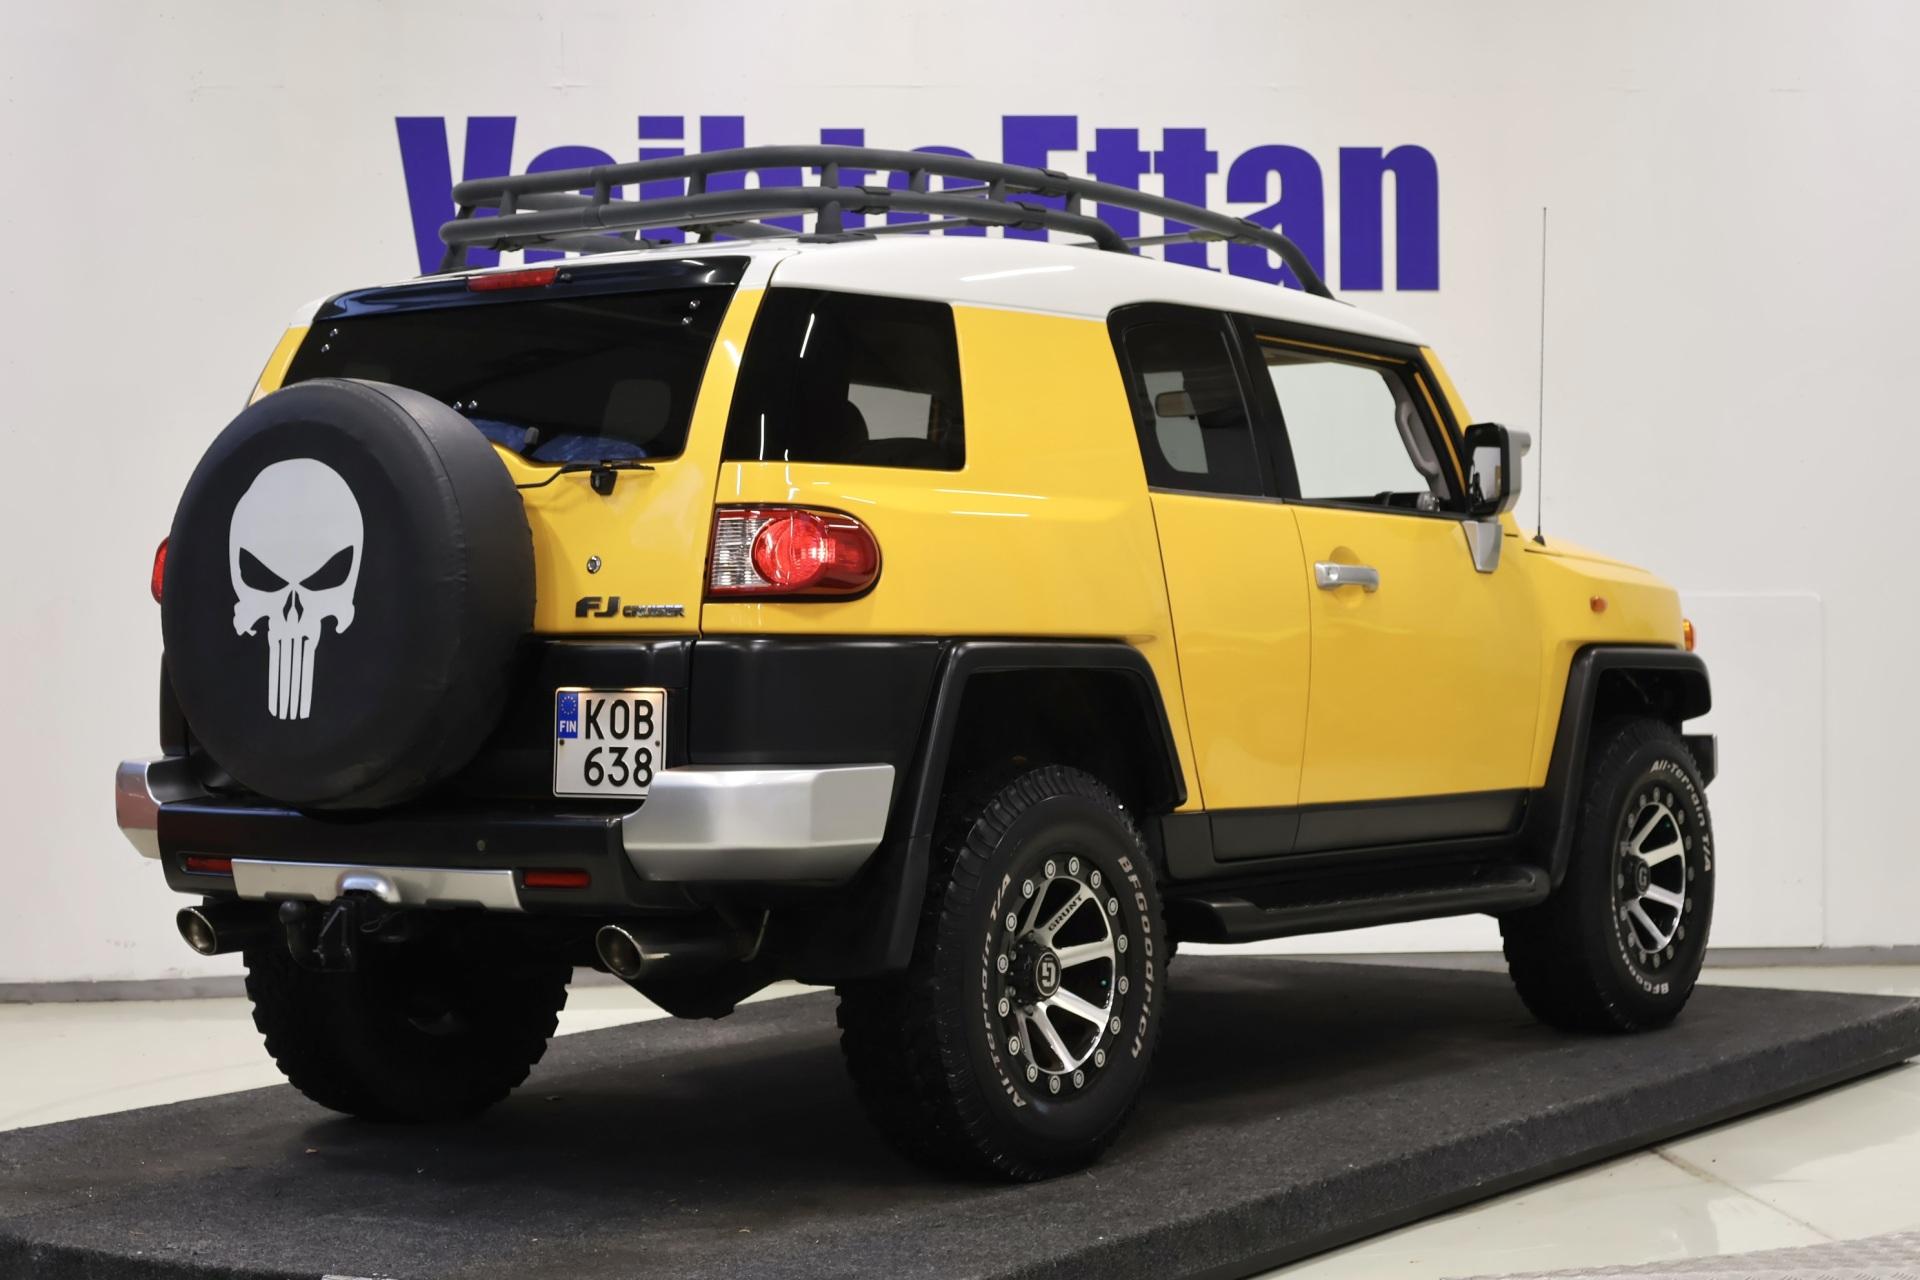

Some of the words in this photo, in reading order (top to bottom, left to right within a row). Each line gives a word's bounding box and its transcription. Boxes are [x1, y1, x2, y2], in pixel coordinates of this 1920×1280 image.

[575, 596, 620, 618] FJ
[560, 720, 577, 733] FIN
[585, 699, 654, 740] KOB
[584, 747, 652, 787] 638
[1048, 896, 1083, 932] GRUNT
